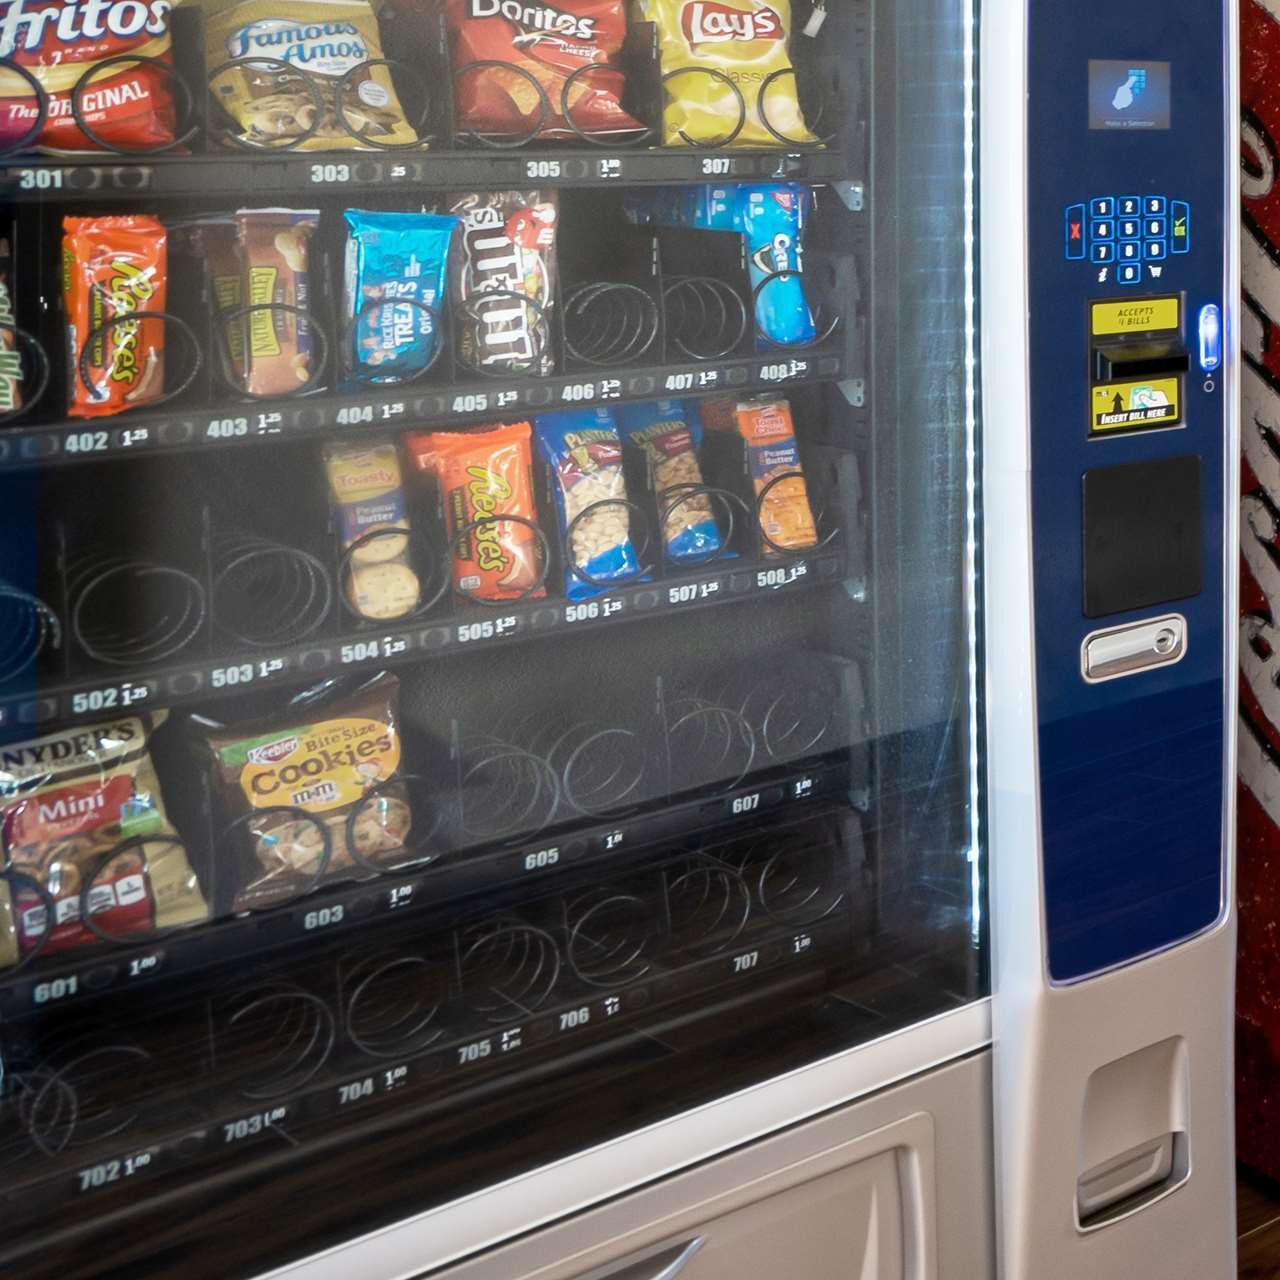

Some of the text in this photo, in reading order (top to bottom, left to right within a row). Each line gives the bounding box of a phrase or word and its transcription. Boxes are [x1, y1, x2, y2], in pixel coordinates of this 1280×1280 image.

[691, 2, 776, 43] Lay's
[232, 21, 358, 58] Famous
[280, 40, 367, 63] Amos
[9, 81, 149, 118] The ORGINAL
[311, 164, 350, 183] 303
[527, 161, 561, 178] 305
[702, 158, 730, 175] 307
[20, 169, 63, 189] 301
[1099, 199, 1159, 214] 1 2 3
[1098, 223, 1107, 236] 4
[1125, 222, 1133, 235] 5
[1150, 221, 1159, 234] 6
[772, 233, 791, 282] OREO
[1099, 243, 1160, 259] 7 8 9
[1125, 266, 1134, 279] 0
[251, 269, 277, 313] ALLEY
[384, 280, 400, 325] KRISIES
[420, 289, 436, 335] Orinal
[1117, 307, 1155, 317] ACCEPTS
[111, 261, 158, 384] Reese's
[1127, 317, 1151, 326] BILLS
[665, 370, 718, 391] 407 1.25
[759, 364, 788, 382] 408
[452, 391, 518, 414] 405 1.25
[561, 384, 594, 402] 406
[207, 412, 282, 438] 403 1.25
[336, 403, 404, 425] 404 1.25
[1101, 407, 1167, 425] INSERT BILL HERE
[65, 428, 149, 453] 402 1.25
[764, 448, 795, 458] Peanut
[765, 456, 794, 465] Butter
[336, 470, 394, 487] Toasty
[355, 503, 396, 514] Peanut
[357, 513, 394, 524] Butter
[466, 466, 510, 573] Reese's
[757, 568, 787, 588] 508
[669, 582, 720, 604] 507 1.25
[566, 601, 599, 621] 506
[458, 622, 494, 642] 505
[341, 641, 379, 663] 504
[212, 659, 284, 688] 503 1.25
[73, 690, 119, 713] 502
[305, 723, 376, 753] Bite Size
[248, 738, 297, 764] Keebler
[251, 735, 392, 796] Cookies
[39, 794, 105, 823] Mini
[732, 793, 760, 815] 607
[525, 847, 560, 870] 605
[304, 884, 413, 930] 603 1.00
[733, 951, 759, 972] 707
[34, 955, 156, 1003] 601 1.00
[560, 1006, 590, 1030] 706
[458, 1039, 491, 1064] 705
[339, 1078, 375, 1105] 704
[224, 1115, 262, 1143] 703
[79, 1154, 151, 1190] 702 1.00
